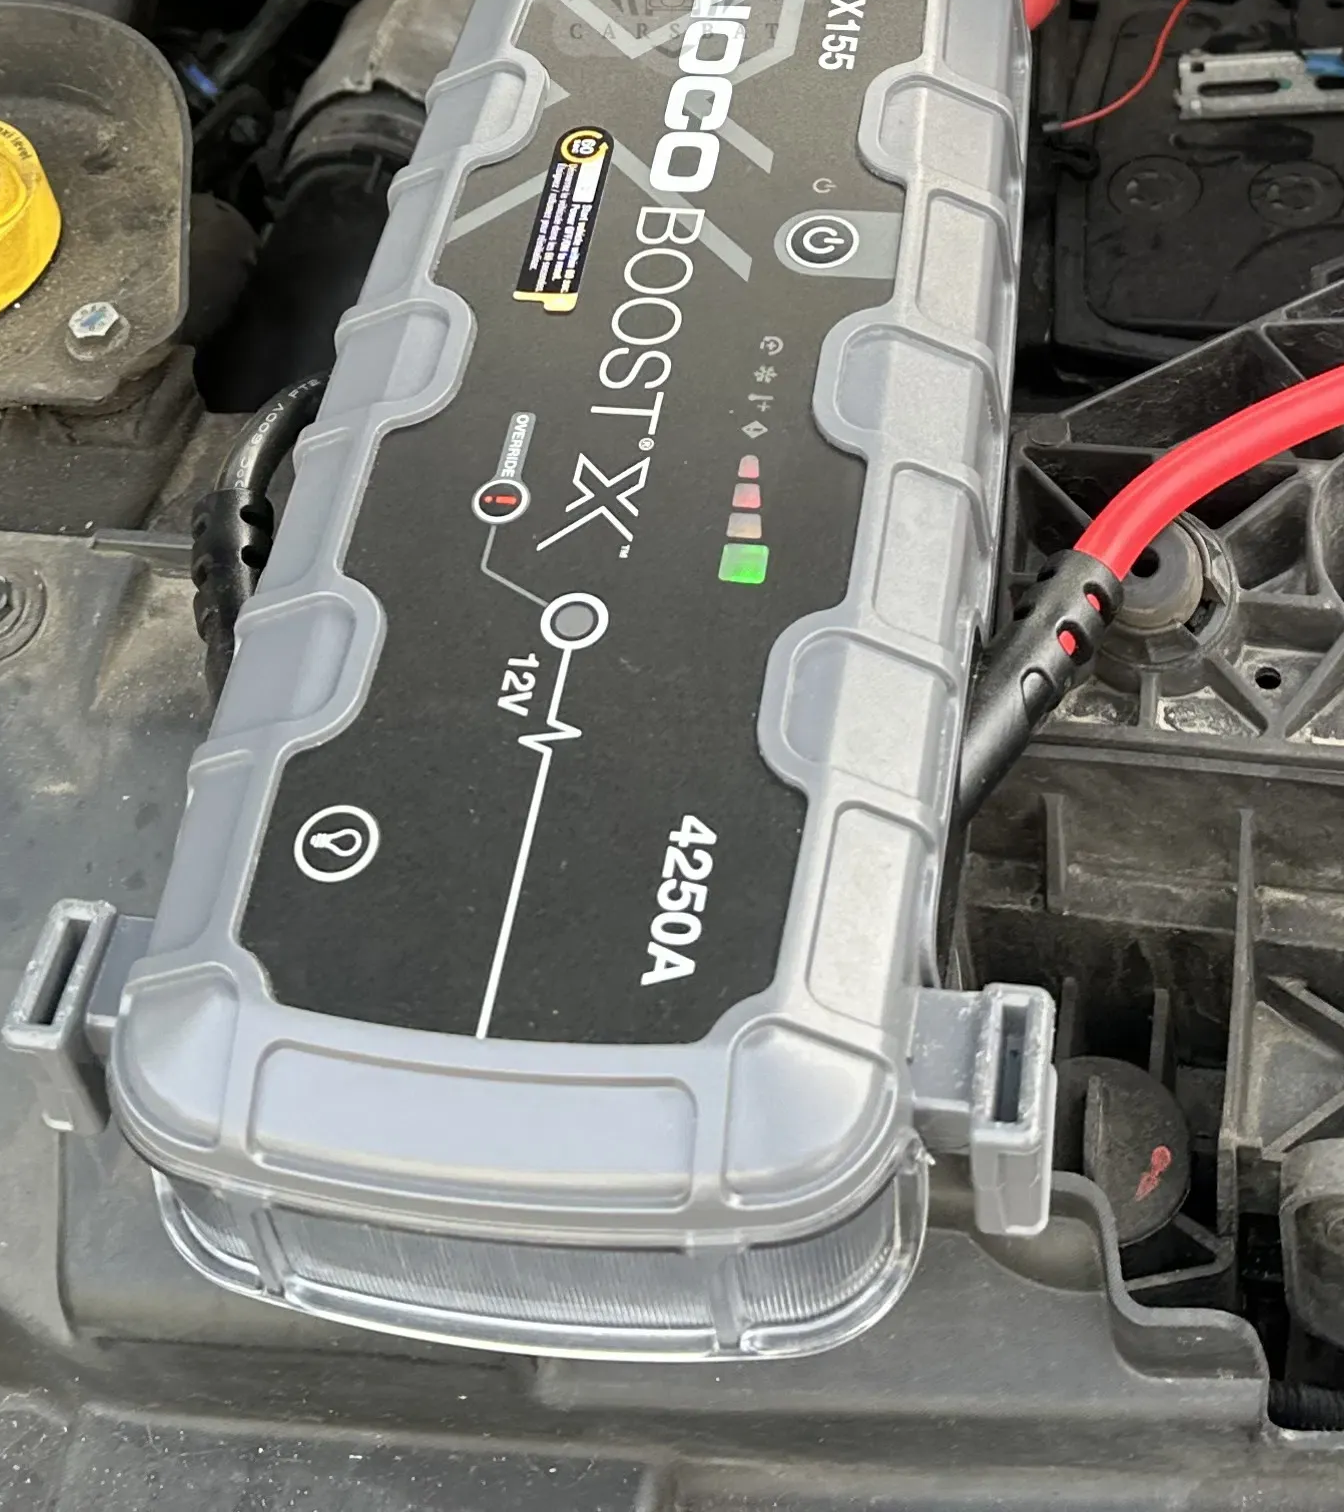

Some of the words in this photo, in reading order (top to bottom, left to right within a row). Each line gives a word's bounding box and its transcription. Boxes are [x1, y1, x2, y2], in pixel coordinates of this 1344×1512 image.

[12, 136, 32, 161] level
[251, 402, 285, 447] 600V
[501, 414, 530, 478] OVERRIDE
[497, 653, 540, 717] 12V
[640, 814, 718, 987] 4250A
